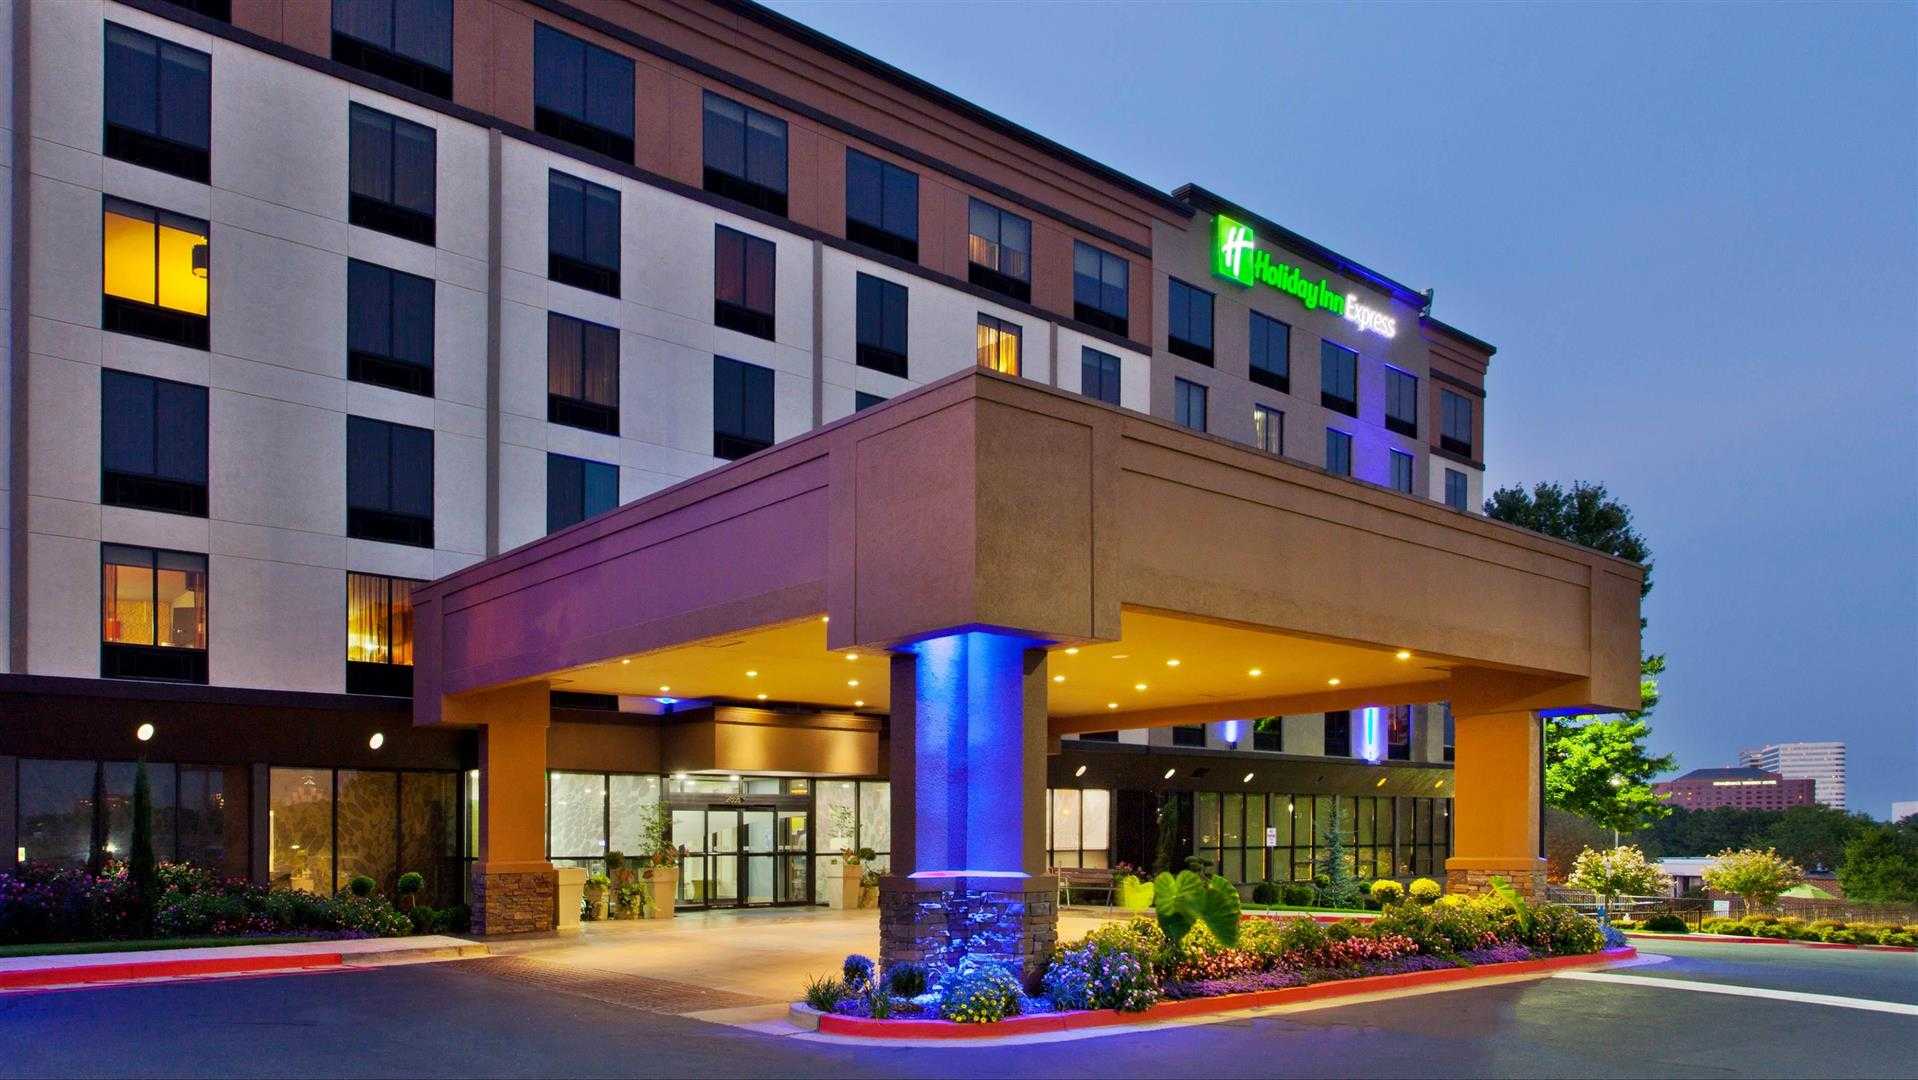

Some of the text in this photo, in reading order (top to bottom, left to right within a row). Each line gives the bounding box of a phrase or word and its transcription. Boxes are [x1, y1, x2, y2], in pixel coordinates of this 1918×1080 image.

[1254, 250, 1396, 338] Holiday Inn Express
